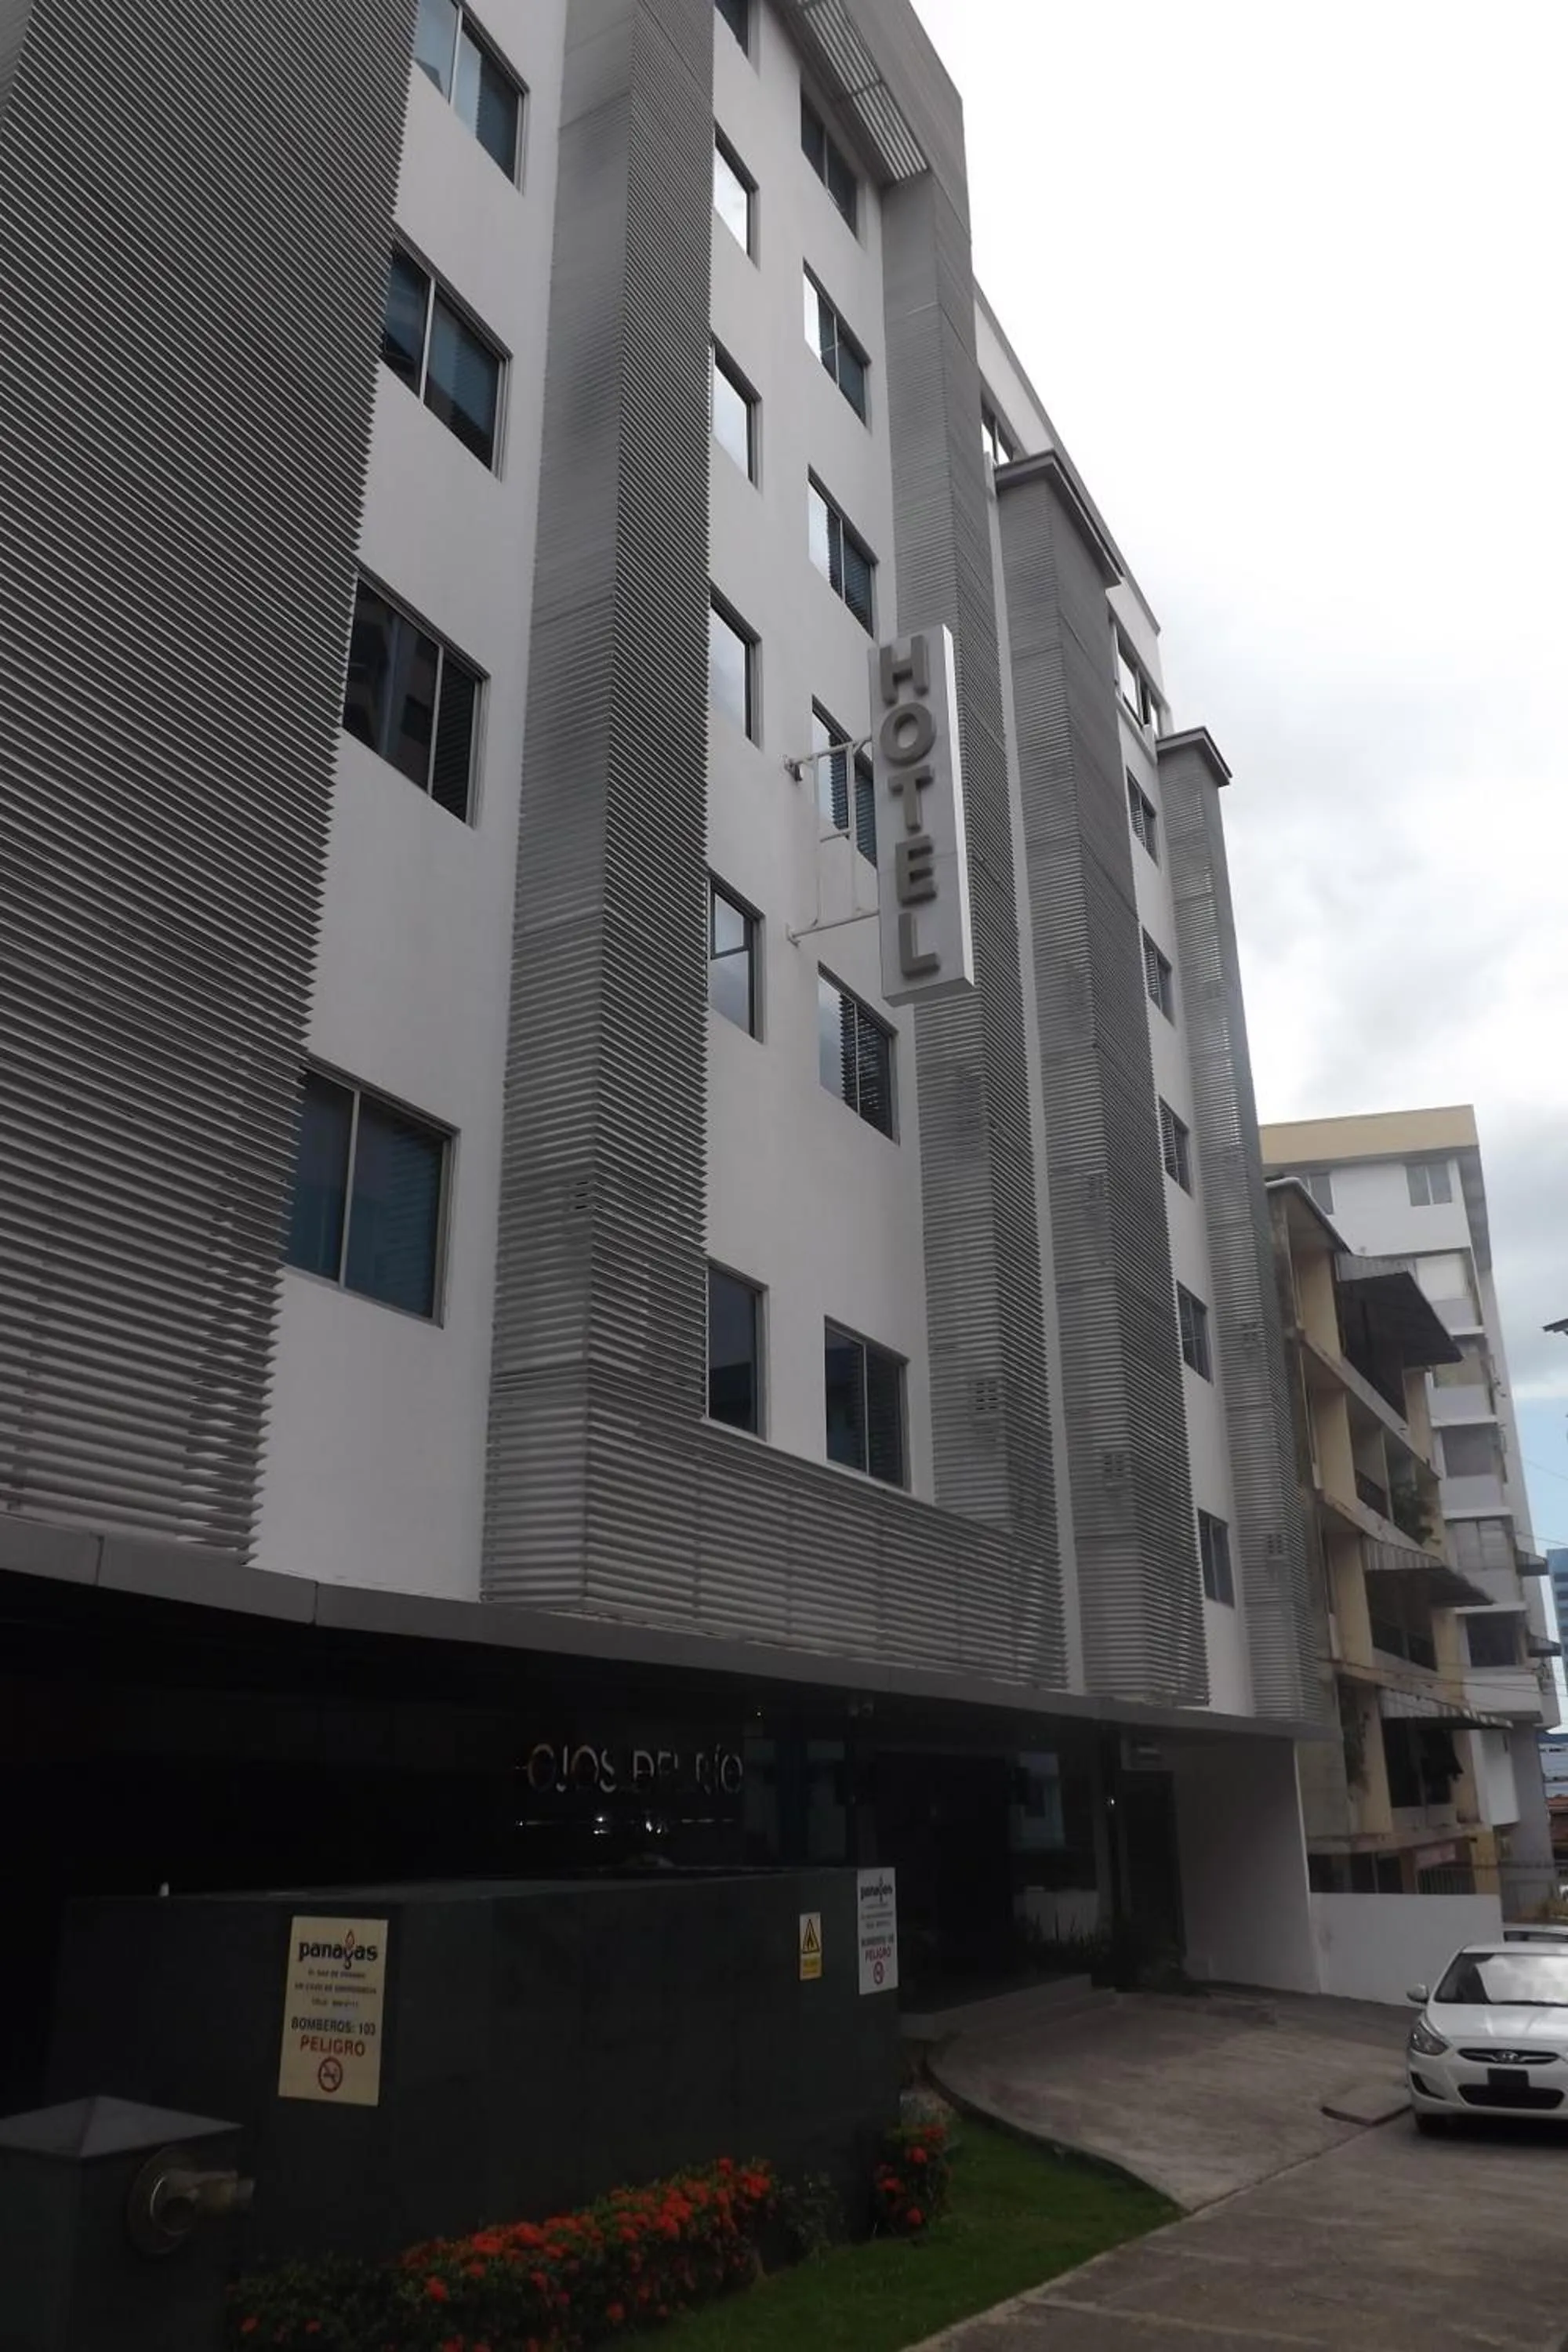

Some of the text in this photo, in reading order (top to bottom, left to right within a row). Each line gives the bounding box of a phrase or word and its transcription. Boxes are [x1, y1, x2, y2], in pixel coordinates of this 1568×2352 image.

[879, 633, 940, 980] HOTEL
[527, 1743, 617, 1793] OJOS
[299, 1941, 378, 1969] panagas
[299, 2034, 366, 2057] PELIGRO
